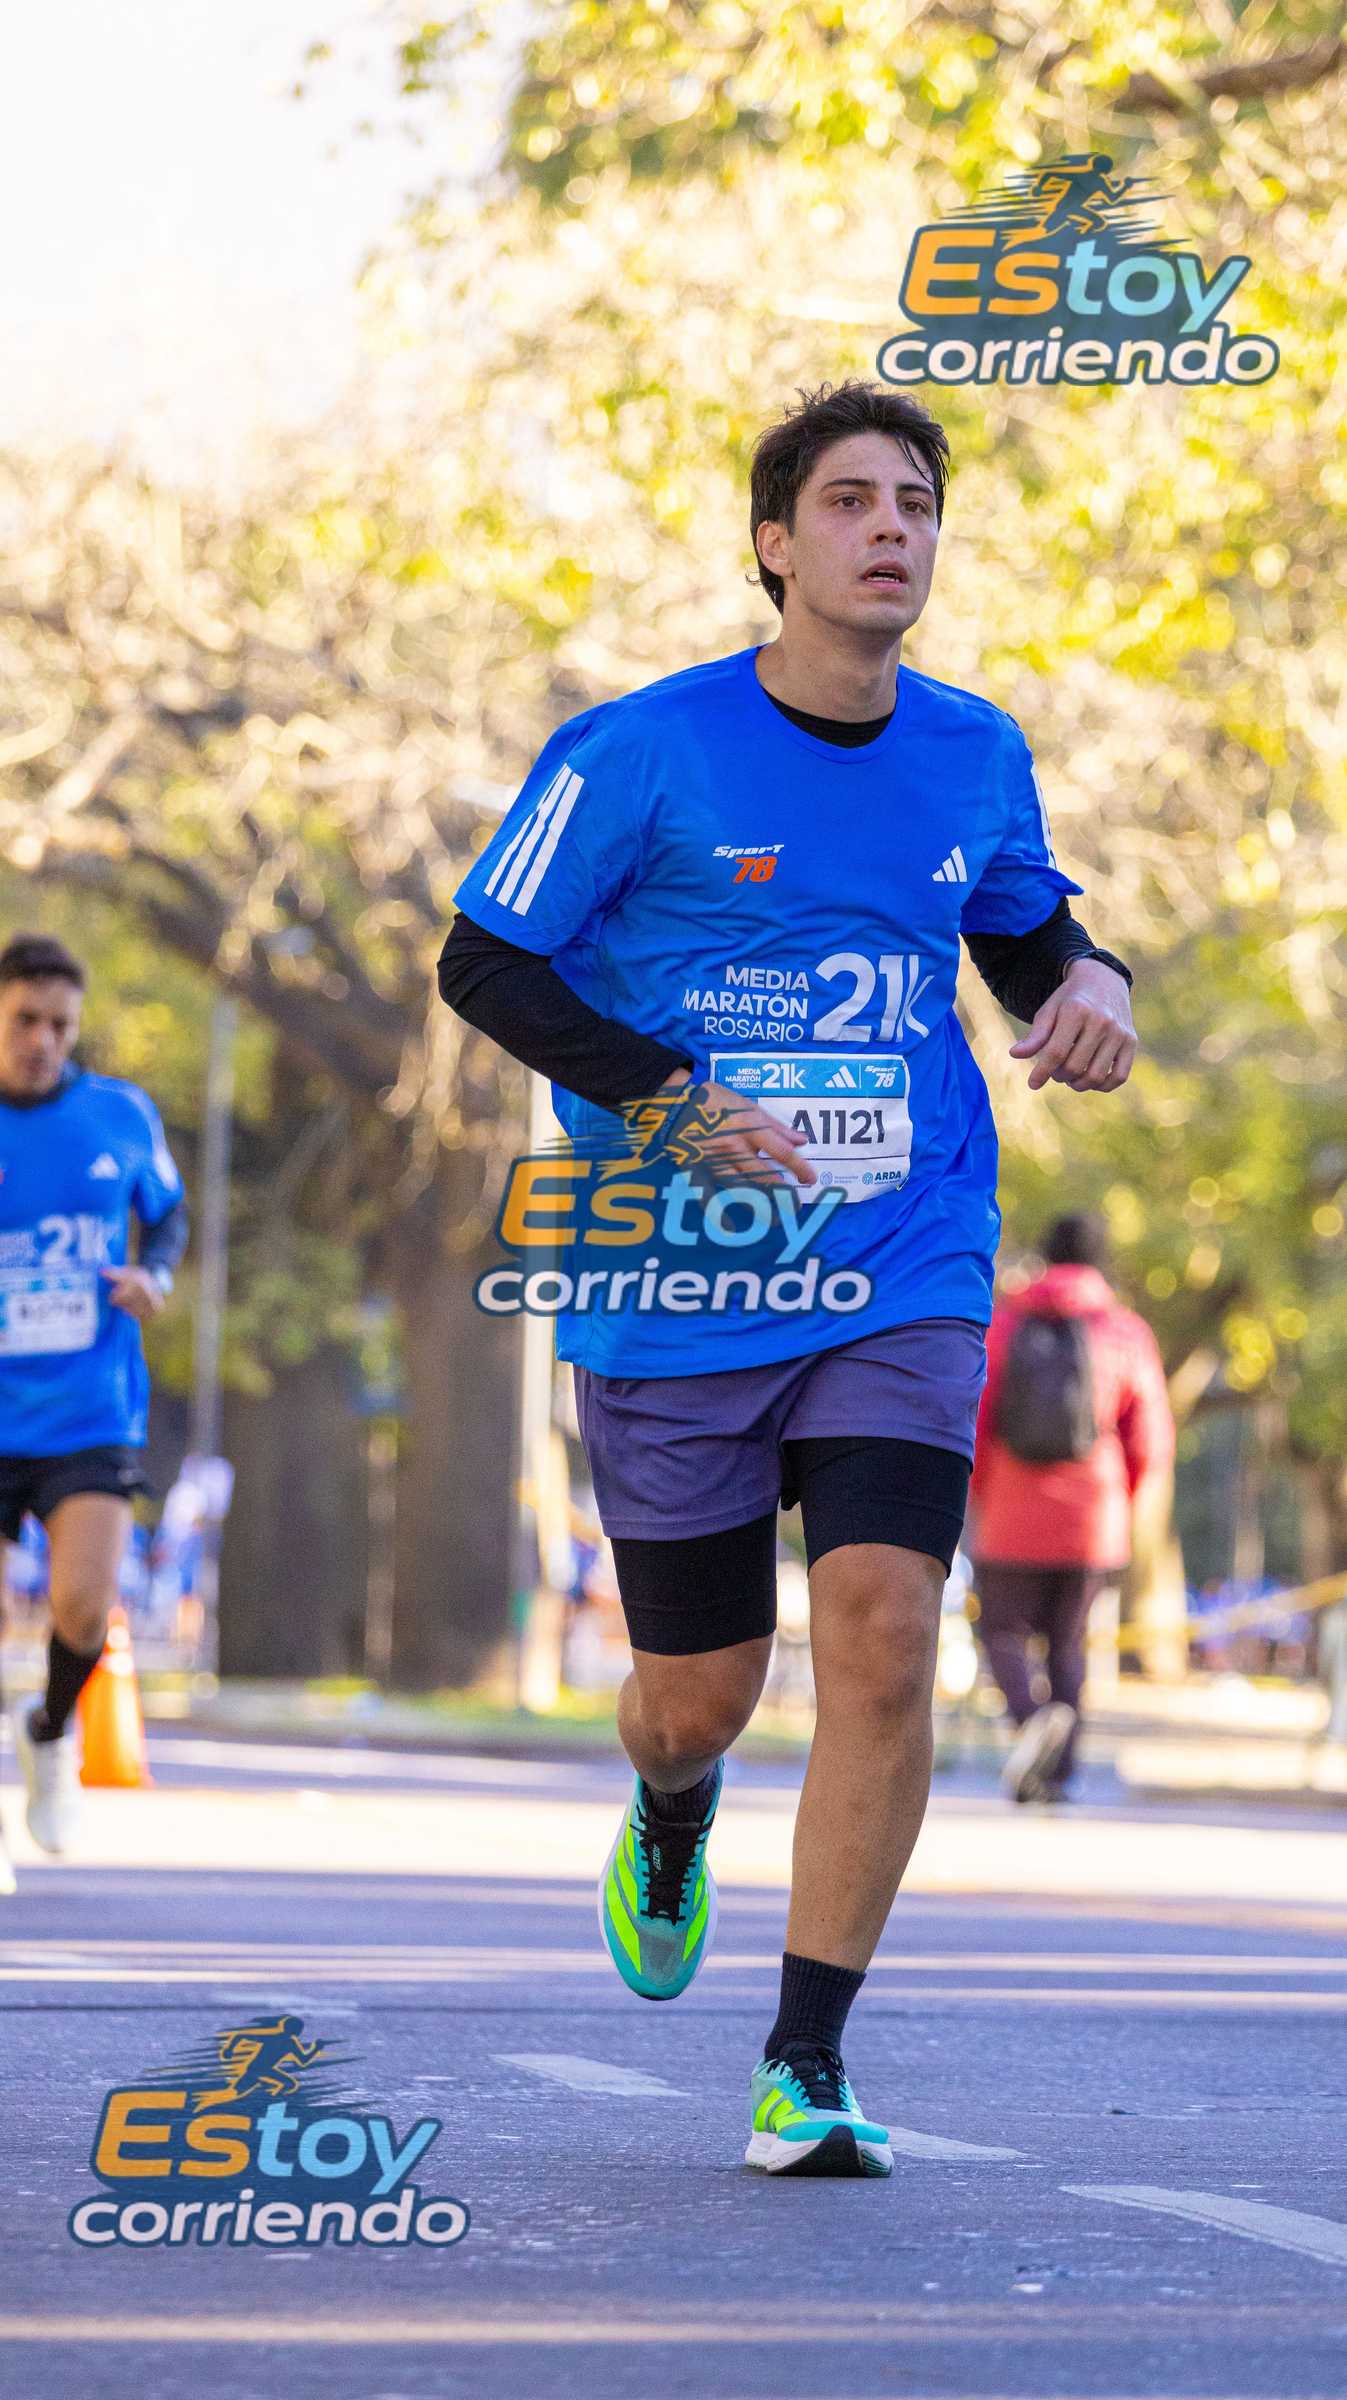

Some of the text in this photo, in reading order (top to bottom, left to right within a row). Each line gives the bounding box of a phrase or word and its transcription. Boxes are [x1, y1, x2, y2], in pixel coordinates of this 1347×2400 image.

[733, 856, 777, 884] 78
[725, 965, 810, 992] MEDIA
[682, 988, 808, 1019] MARATÓN
[704, 1016, 804, 1042] ROSARIO
[725, 1074, 761, 1082] MARATÓN
[874, 1073, 896, 1088] 78
[791, 1109, 885, 1145] A1121
[875, 1171, 901, 1181] ARDA
